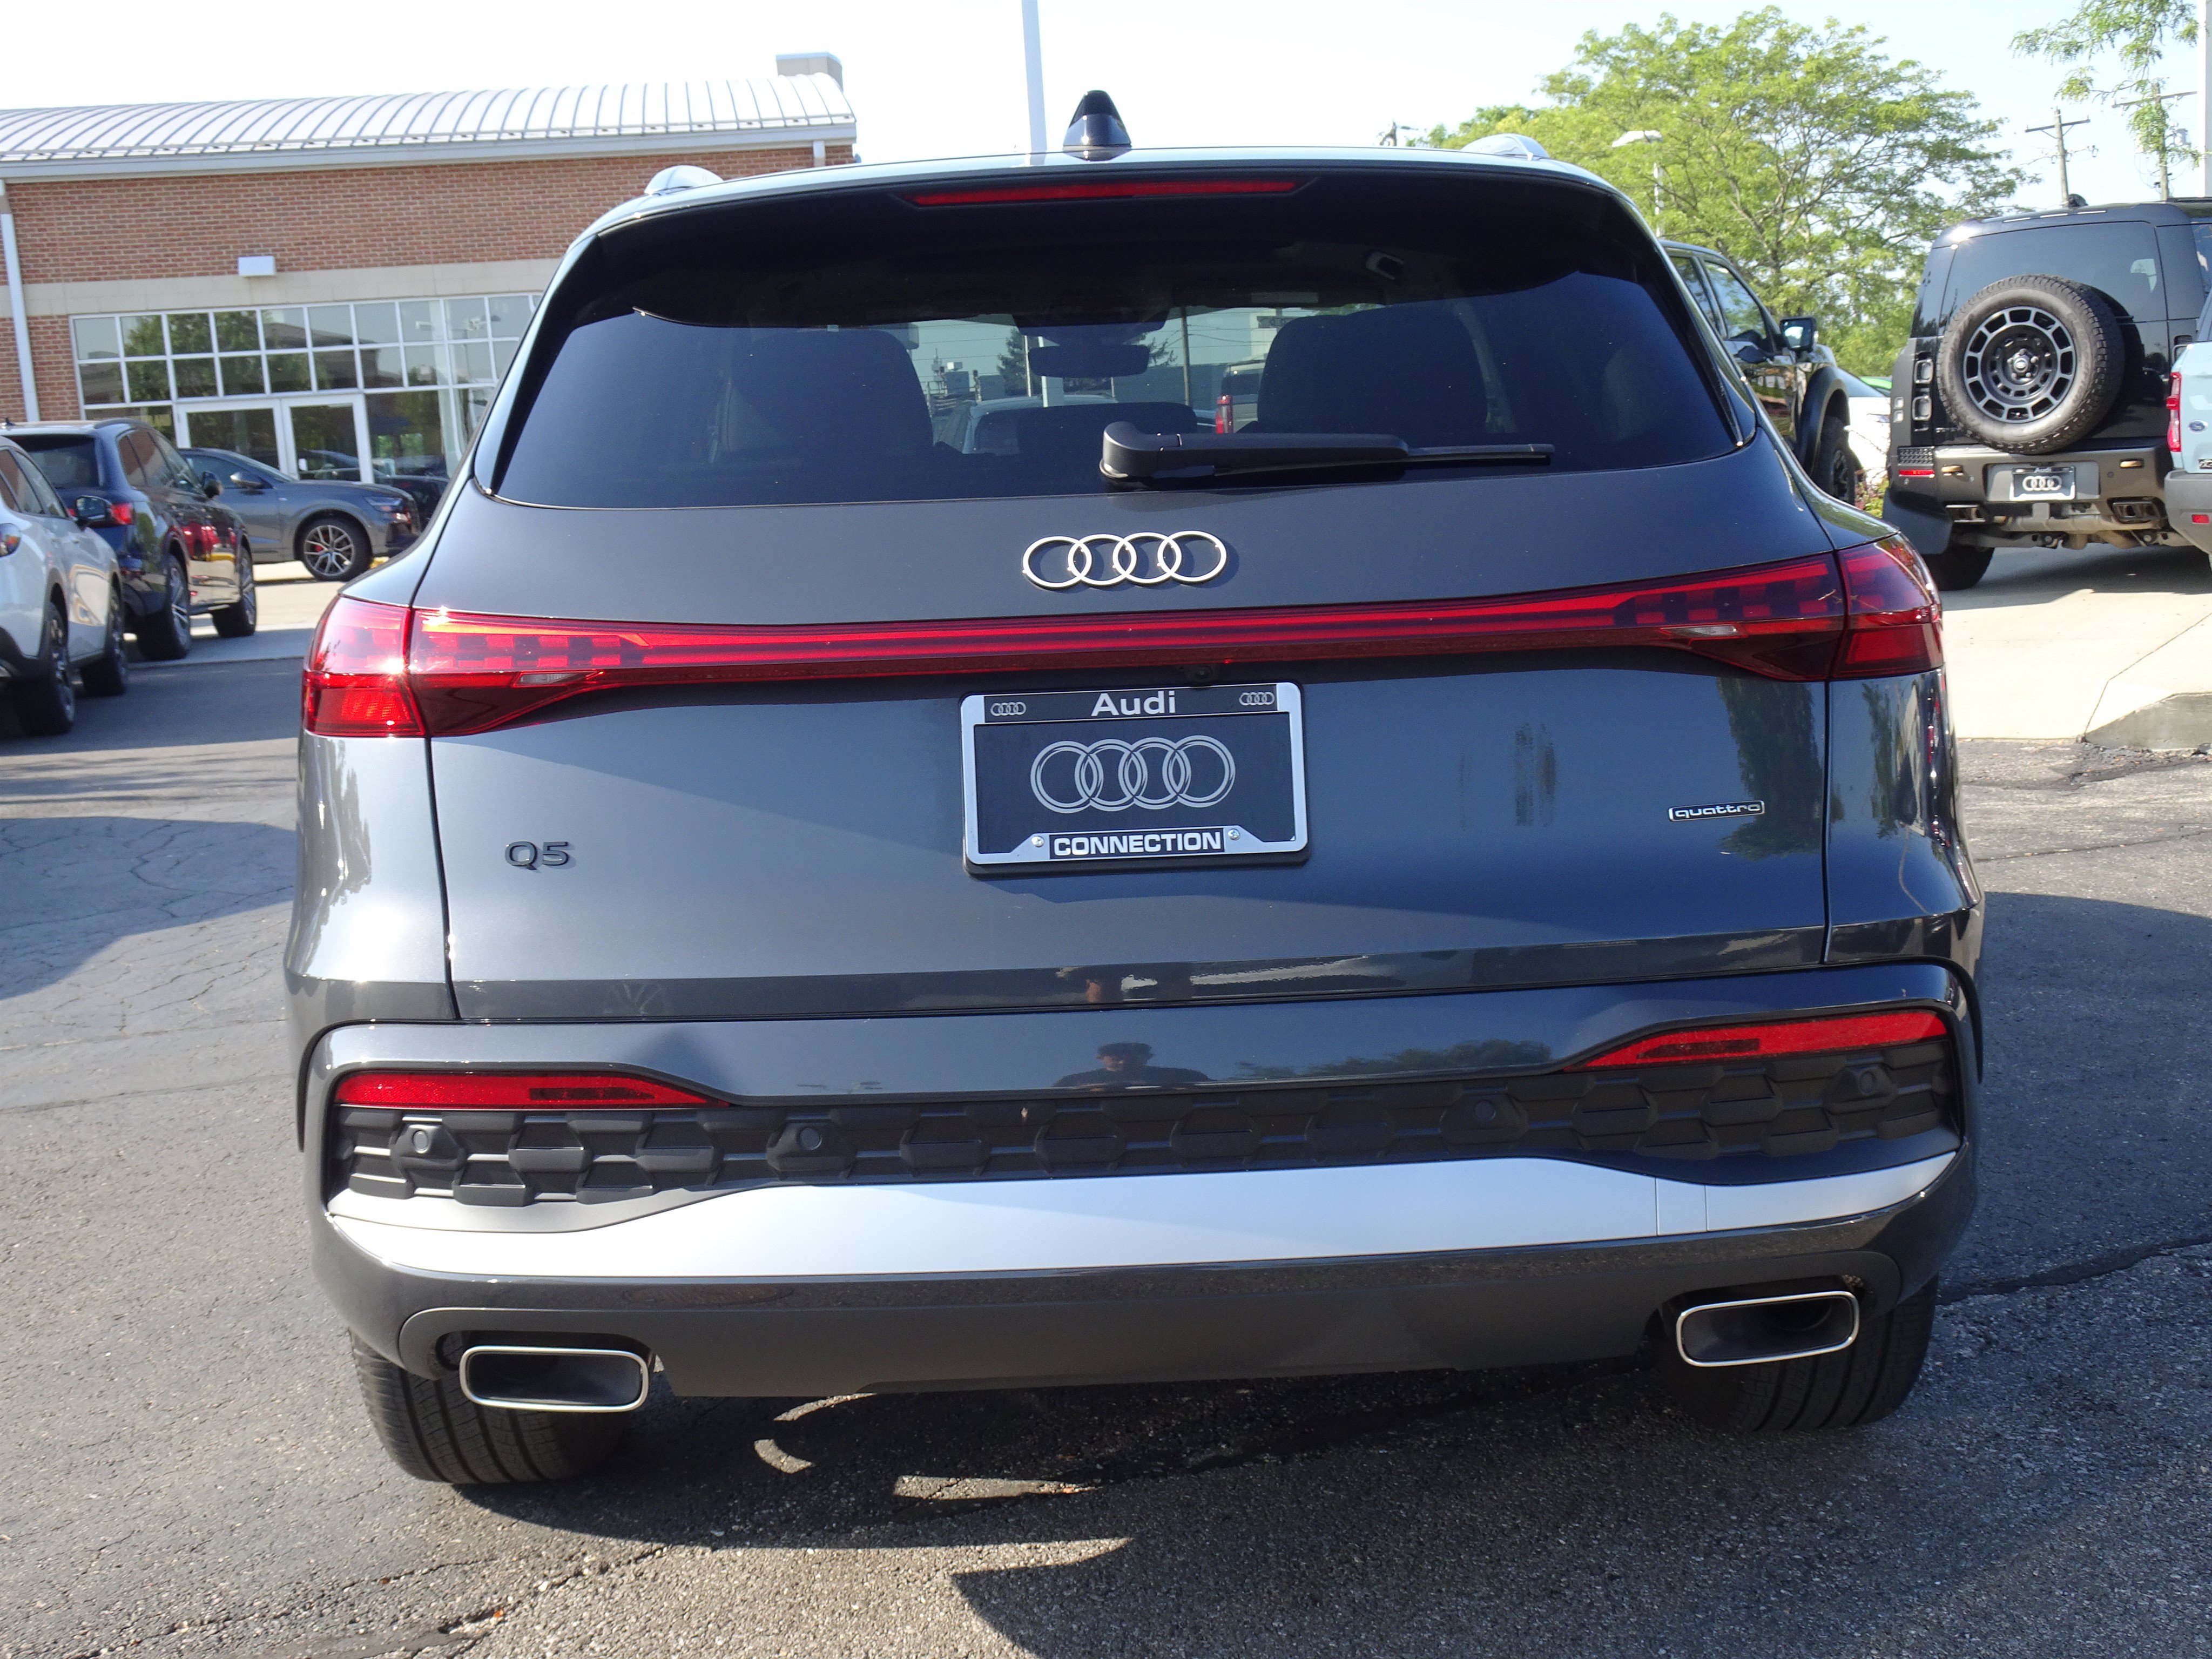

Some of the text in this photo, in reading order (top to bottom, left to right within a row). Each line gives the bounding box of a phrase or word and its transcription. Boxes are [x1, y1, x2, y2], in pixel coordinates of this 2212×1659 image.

[1091, 690, 1176, 716] Audi
[1675, 804, 1761, 818] quattro
[504, 841, 569, 870] Q5
[1054, 832, 1221, 856] CONNECTION
